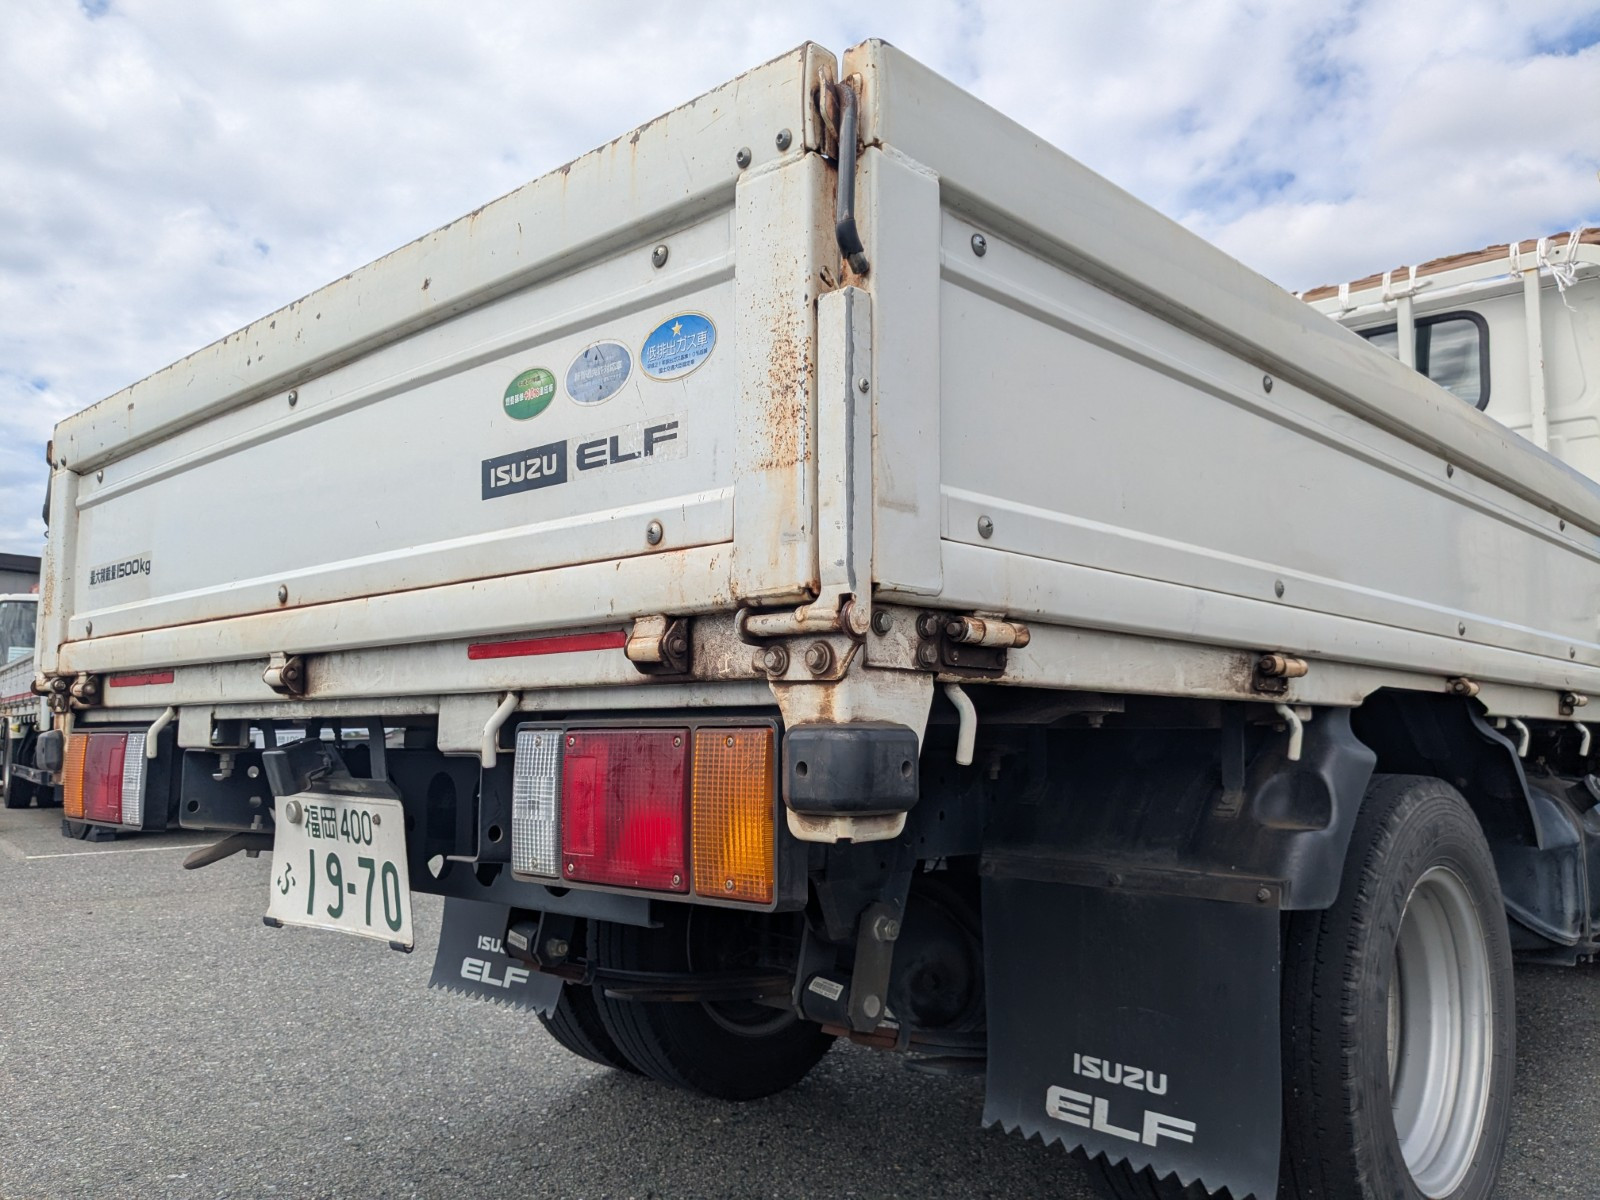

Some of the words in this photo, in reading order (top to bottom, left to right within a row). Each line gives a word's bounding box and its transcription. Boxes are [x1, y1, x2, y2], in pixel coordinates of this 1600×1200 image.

[647, 331, 708, 362] 低排出ガス車
[490, 453, 557, 488] ISUZU
[576, 420, 679, 471] ELF
[277, 862, 296, 895] ふ
[306, 849, 402, 932] 19-70
[477, 935, 506, 955] ISU
[460, 956, 530, 989] ELF
[1073, 1052, 1168, 1095] ISUZU
[1045, 1084, 1197, 1147] ELF
